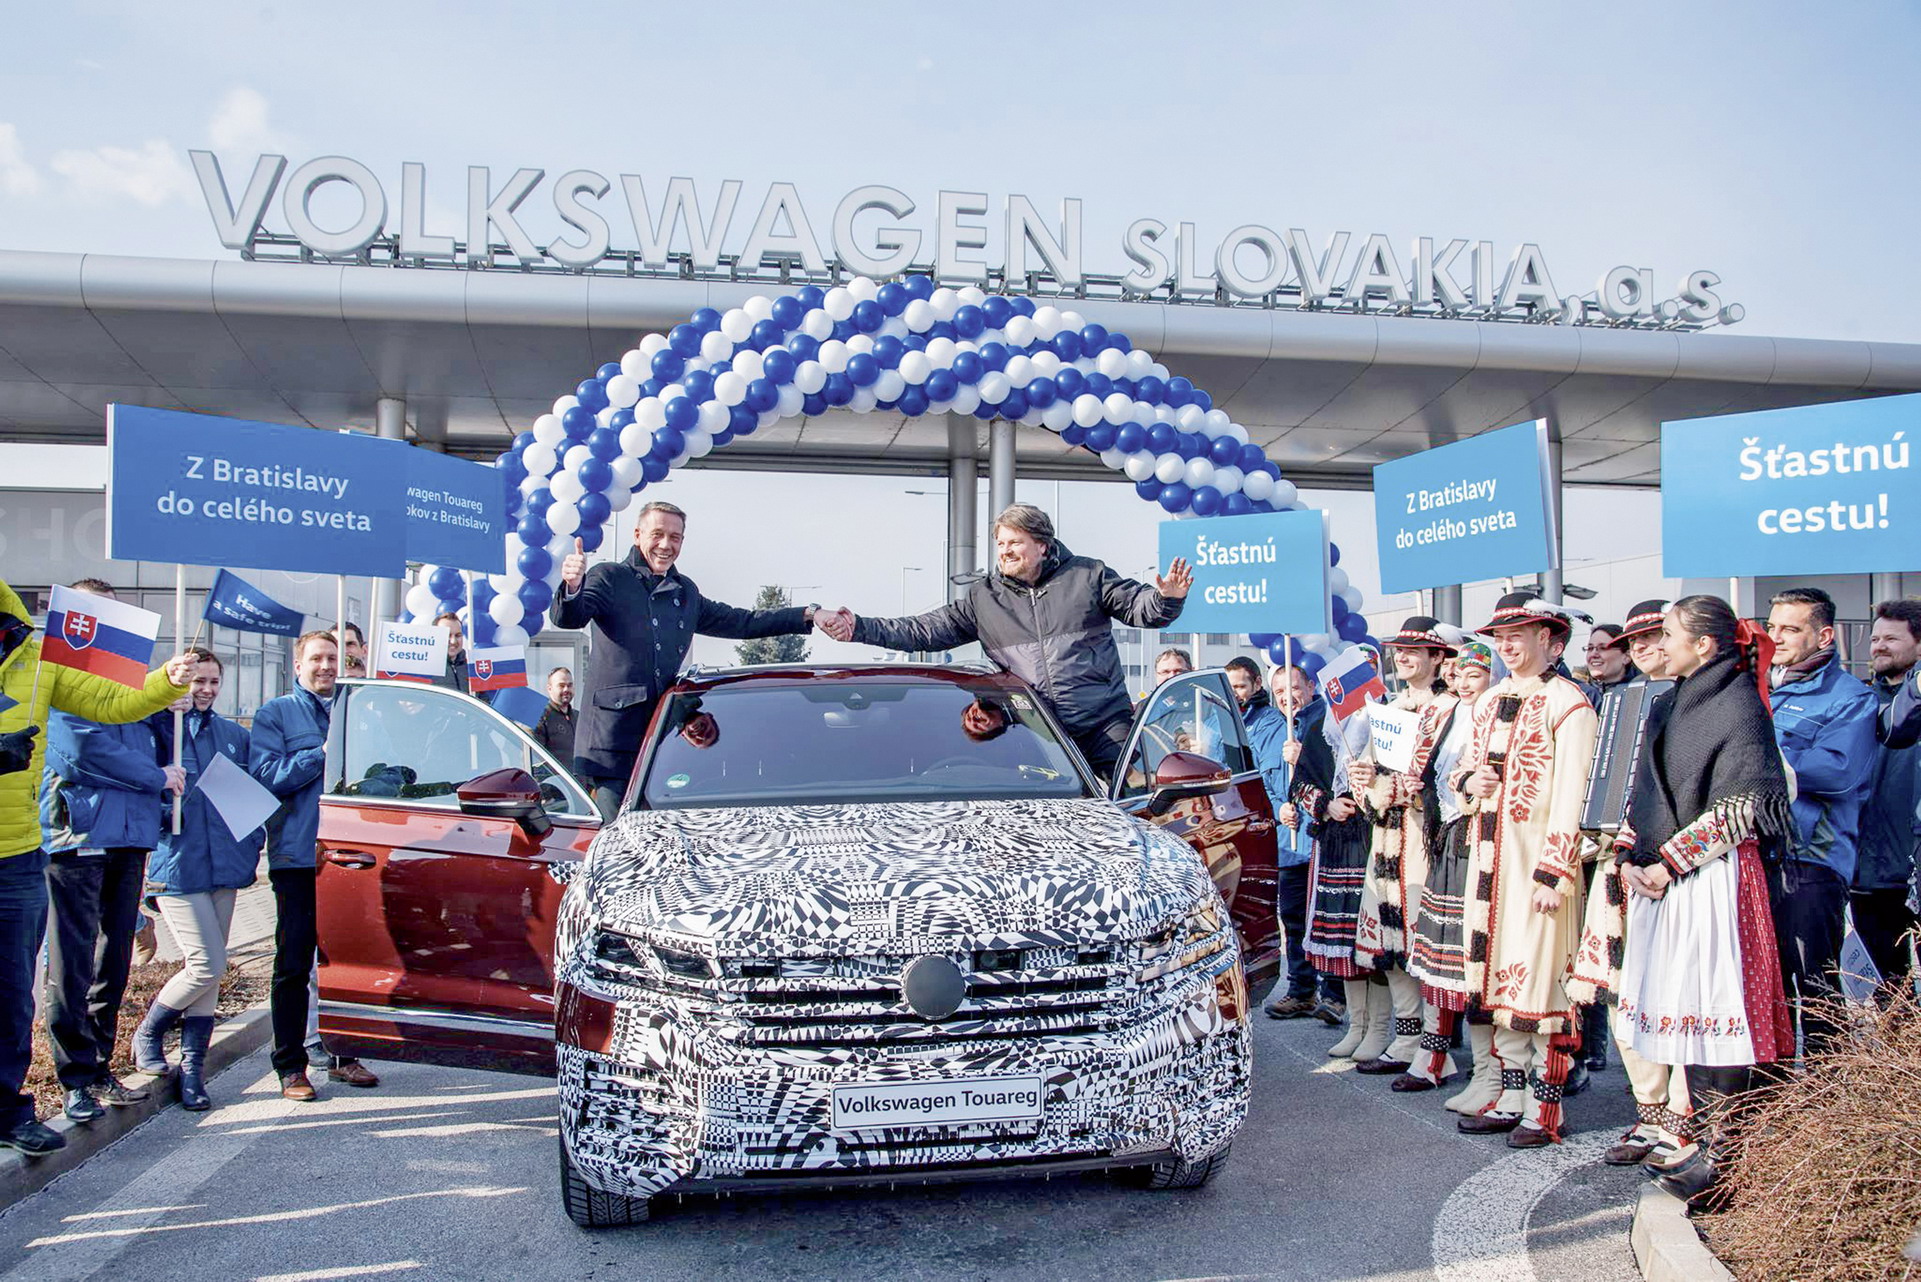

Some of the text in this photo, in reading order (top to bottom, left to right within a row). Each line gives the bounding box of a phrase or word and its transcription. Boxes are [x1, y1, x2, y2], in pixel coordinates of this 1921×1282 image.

[188, 149, 1083, 289] VOLKSWAGEN
[1596, 264, 1746, 325] a.s.
[1739, 431, 1909, 481] Šťastnú
[186, 455, 349, 500] Z Bratislavy
[157, 490, 372, 532] do celého sveta
[443, 491, 483, 514] Touareg
[1406, 478, 1497, 515] Z Bratislavy
[432, 511, 438, 521] z
[440, 510, 490, 534] Bratislavy
[1757, 493, 1890, 535] cestu!
[1395, 510, 1517, 549] do celého sveta
[1196, 534, 1276, 566] Šťastnú
[212, 600, 222, 611] a
[1204, 578, 1267, 604] cestu!
[235, 593, 272, 620] Have
[387, 630, 436, 646] Šťastnú
[391, 650, 428, 661] cestu!
[838, 1090, 1038, 1114] Volkswagen Touareg
